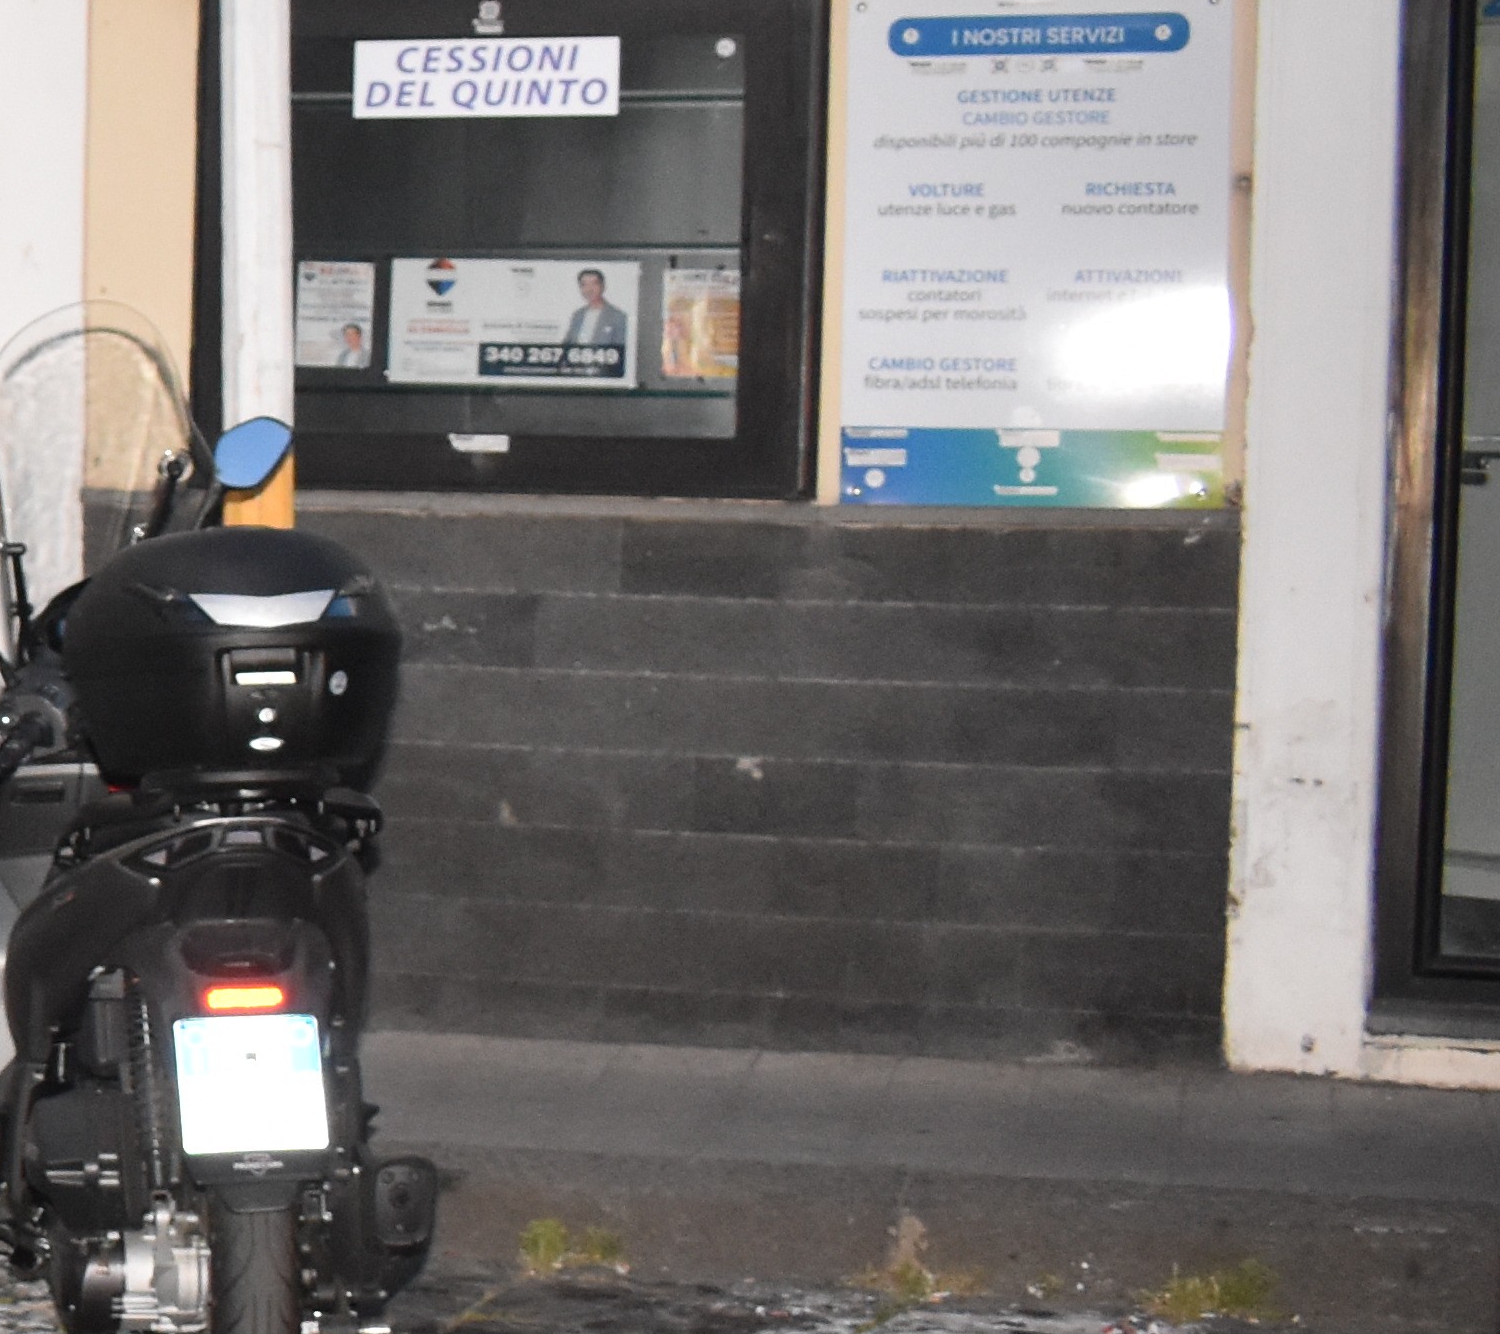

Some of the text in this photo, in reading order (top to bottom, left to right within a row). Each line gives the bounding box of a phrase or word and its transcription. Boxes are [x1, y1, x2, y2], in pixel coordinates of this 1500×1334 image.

[963, 27, 1041, 46] NOSTRI
[1046, 26, 1125, 45] SERVIZI
[397, 44, 580, 74] CESSIONI
[365, 78, 609, 111] DEL QUINTO
[957, 88, 1116, 104] GESTIONE UTENZE
[962, 110, 1110, 126] CAMBIO GESTORE
[990, 133, 1006, 148] di
[1010, 134, 1038, 148] 100
[1136, 133, 1152, 147] in
[908, 183, 984, 198] VOLTURE
[1085, 182, 1176, 197] RICHIESTA
[877, 204, 932, 217] utenze
[937, 201, 970, 217] luce
[988, 204, 1016, 220] gas
[882, 269, 1009, 284] RIATTIVAZIONE
[868, 357, 1018, 372] CAMBIO GESTORE
